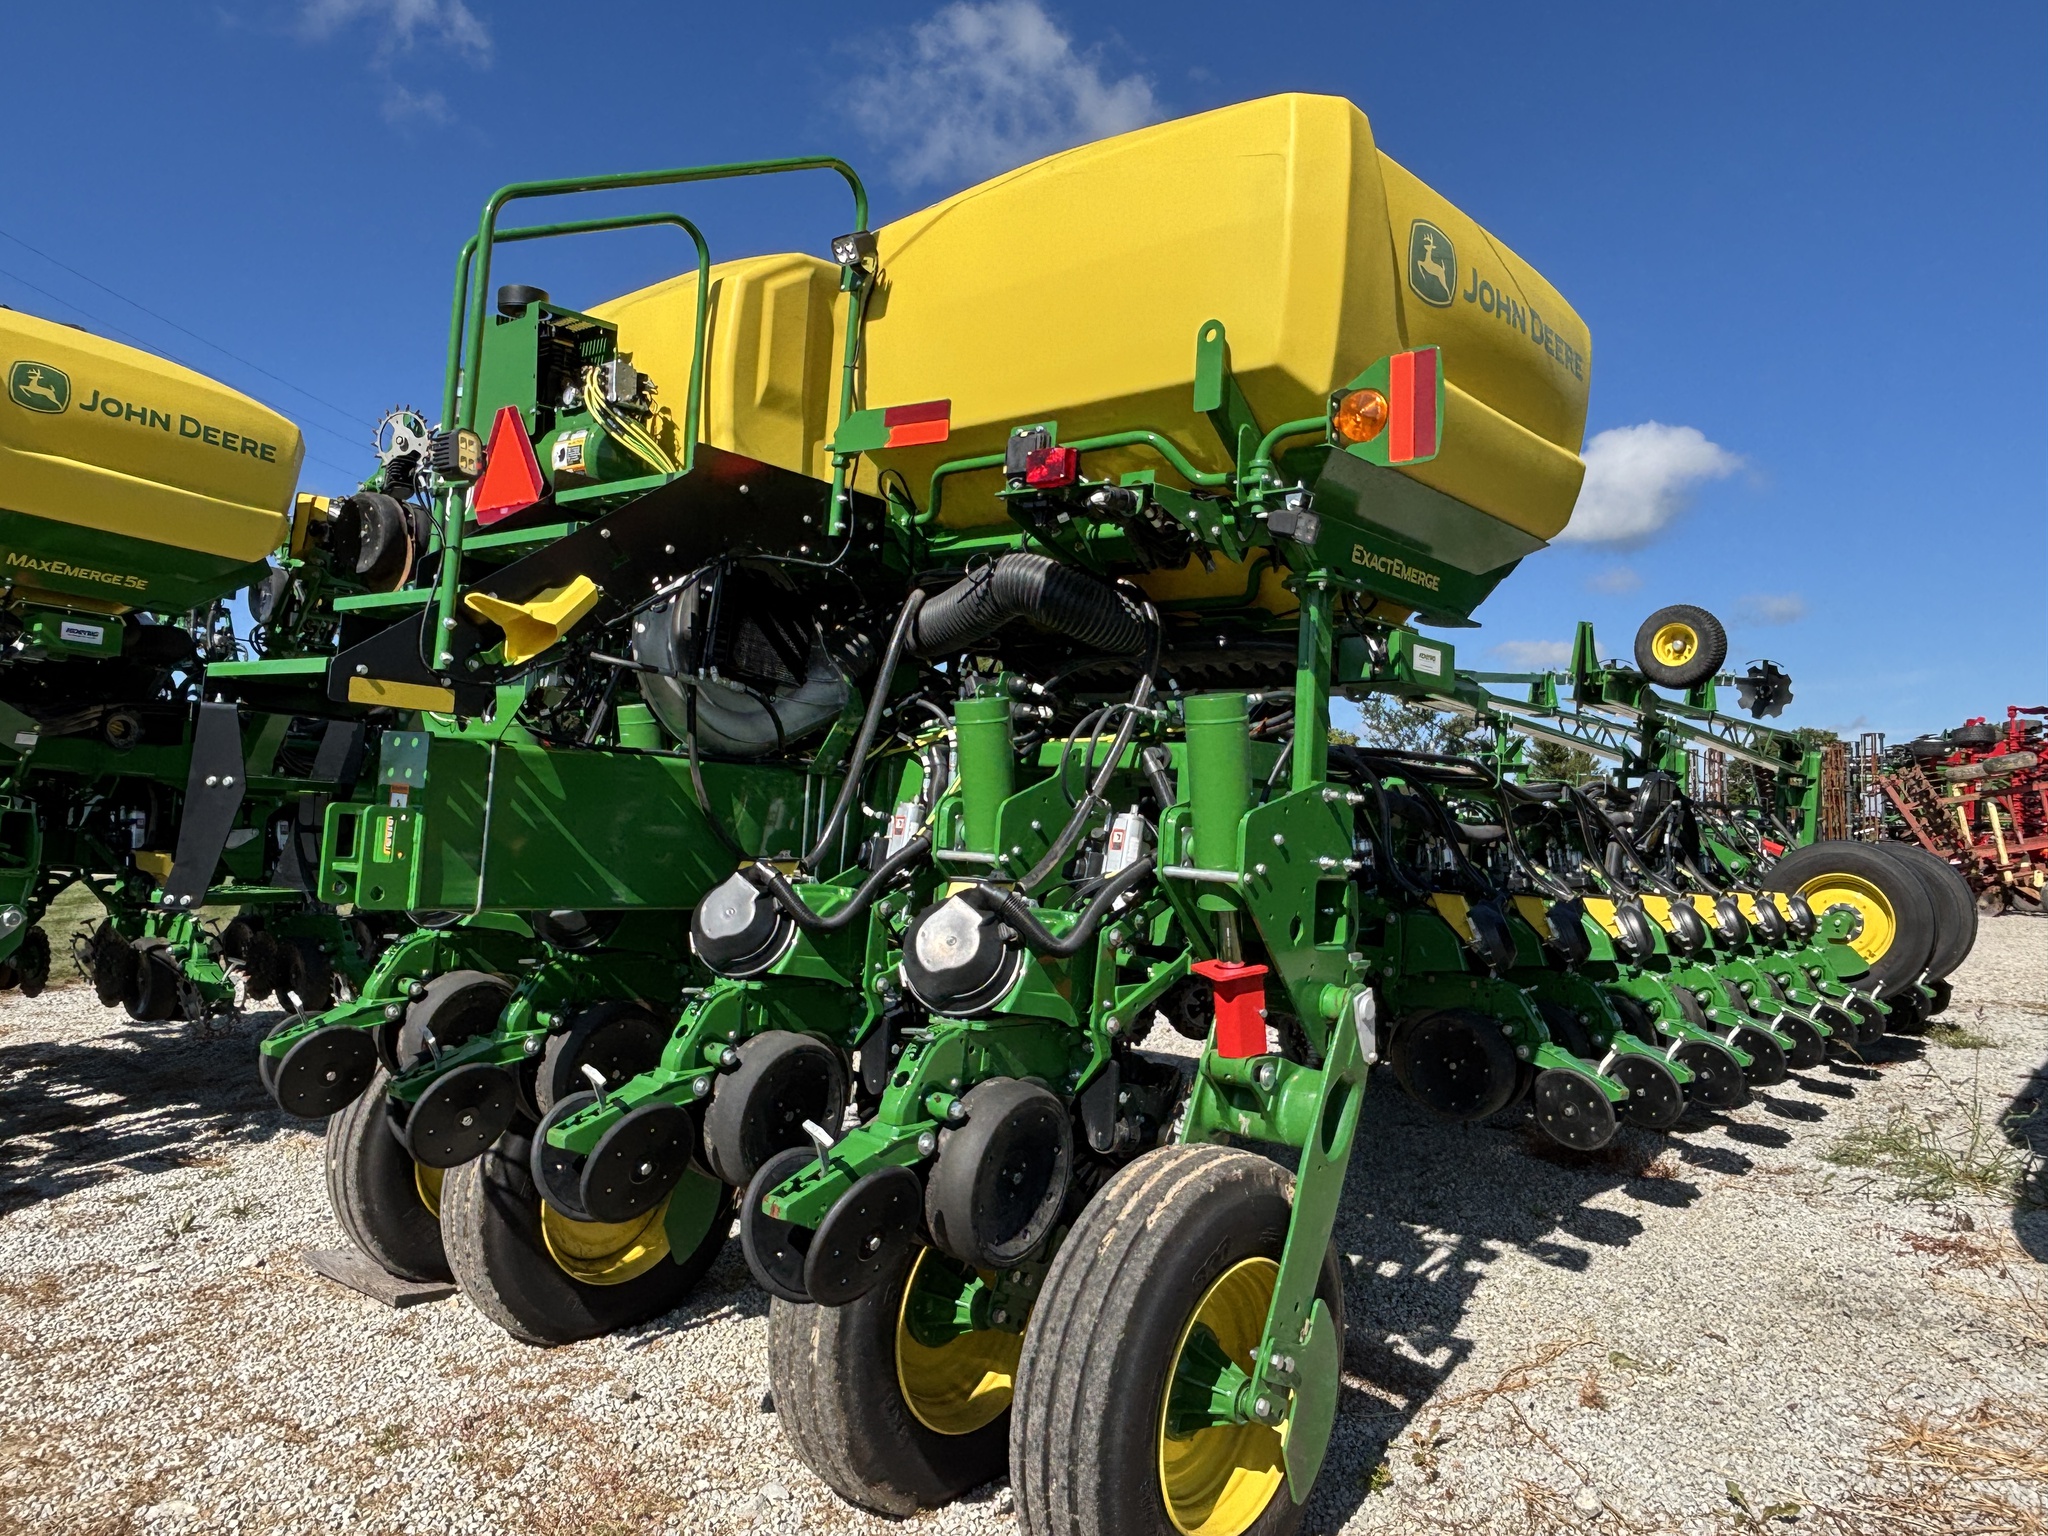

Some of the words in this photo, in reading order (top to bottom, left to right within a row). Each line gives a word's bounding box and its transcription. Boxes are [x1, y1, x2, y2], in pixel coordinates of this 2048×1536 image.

[1463, 267, 1526, 335] JOHN
[1529, 306, 1583, 382] DEERE
[79, 389, 171, 432] JOHN
[179, 414, 277, 464] DEERE
[123, 575, 149, 590] 5E
